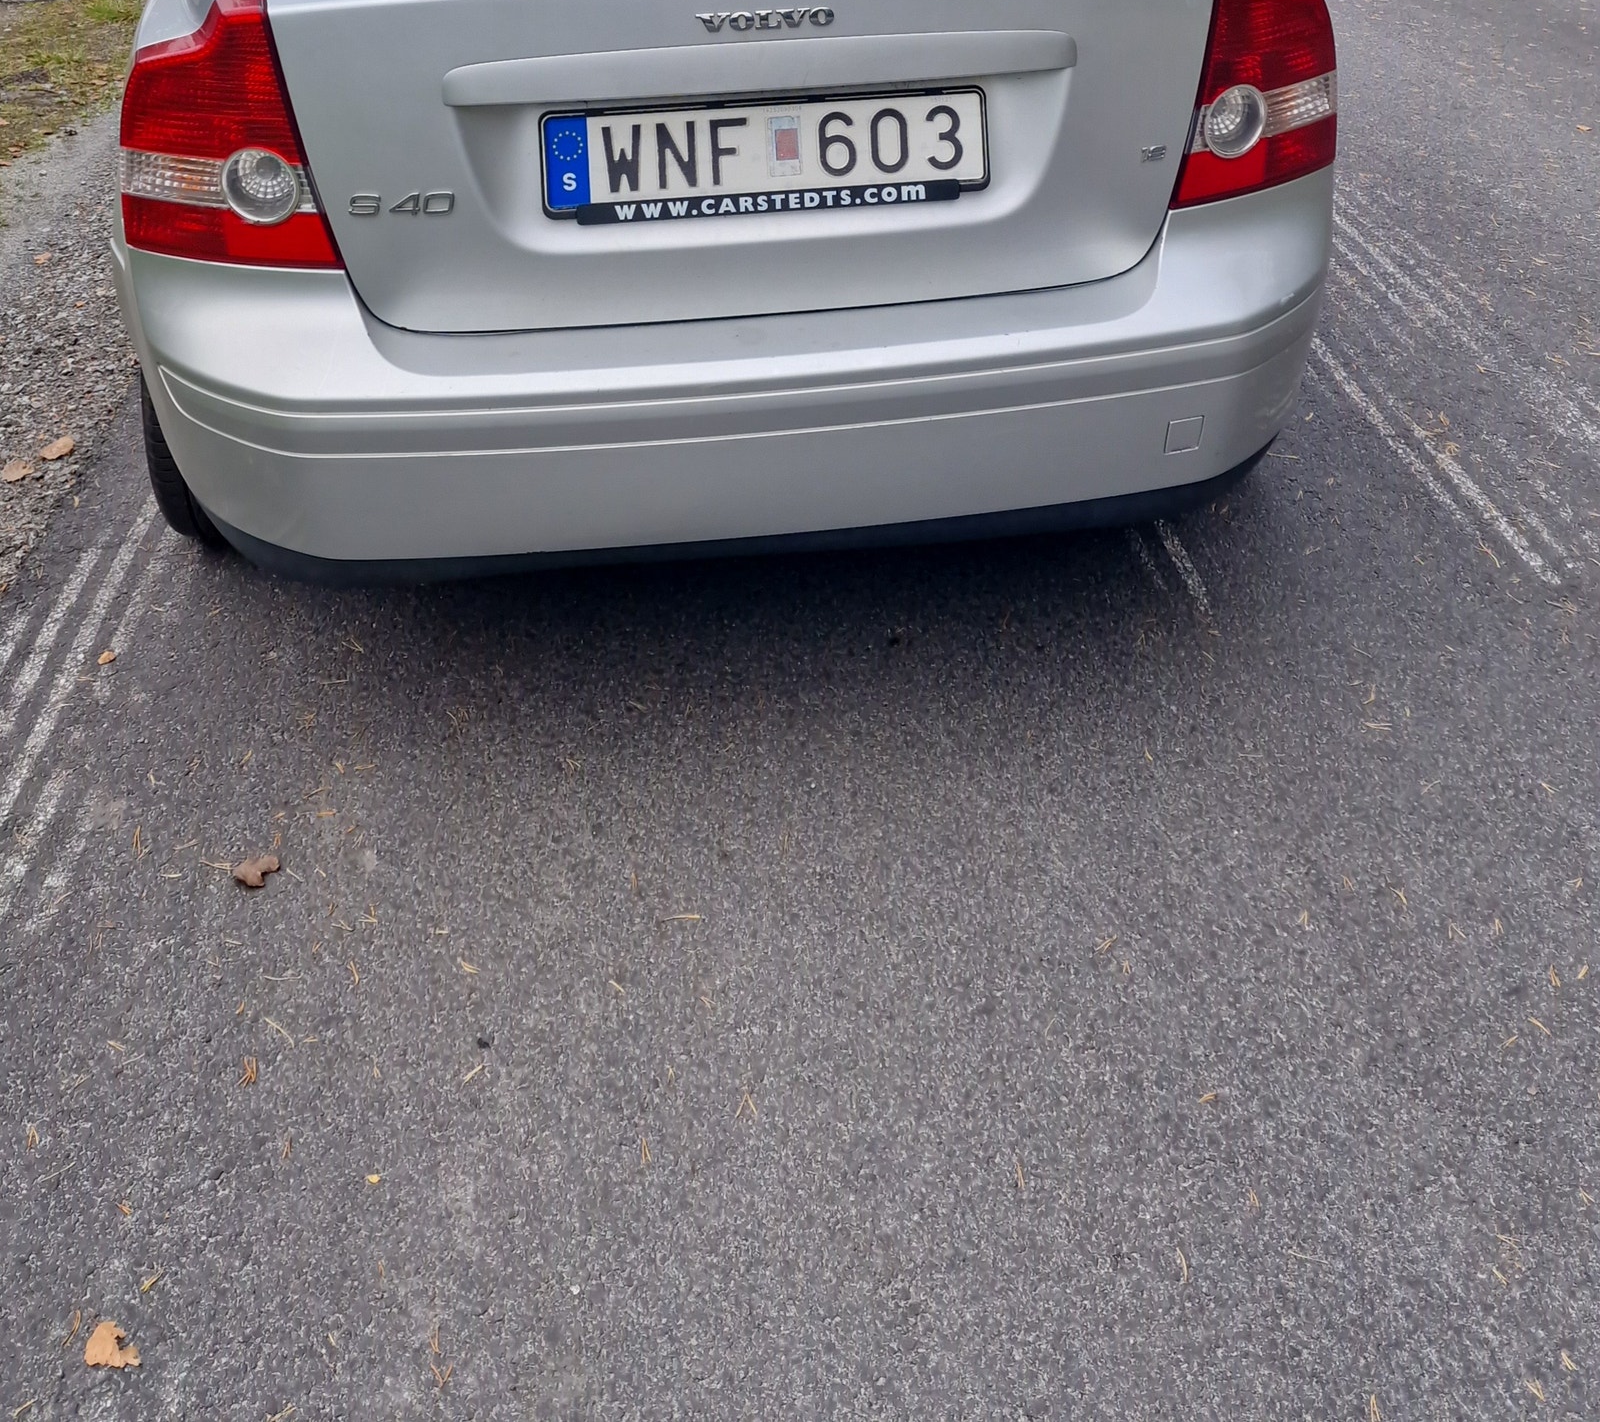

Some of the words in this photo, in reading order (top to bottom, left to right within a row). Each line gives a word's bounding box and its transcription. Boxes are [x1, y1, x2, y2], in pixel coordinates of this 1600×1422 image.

[695, 6, 835, 33] VOLVO
[601, 117, 747, 193] WNF
[818, 104, 964, 177] 603
[562, 173, 577, 192] S
